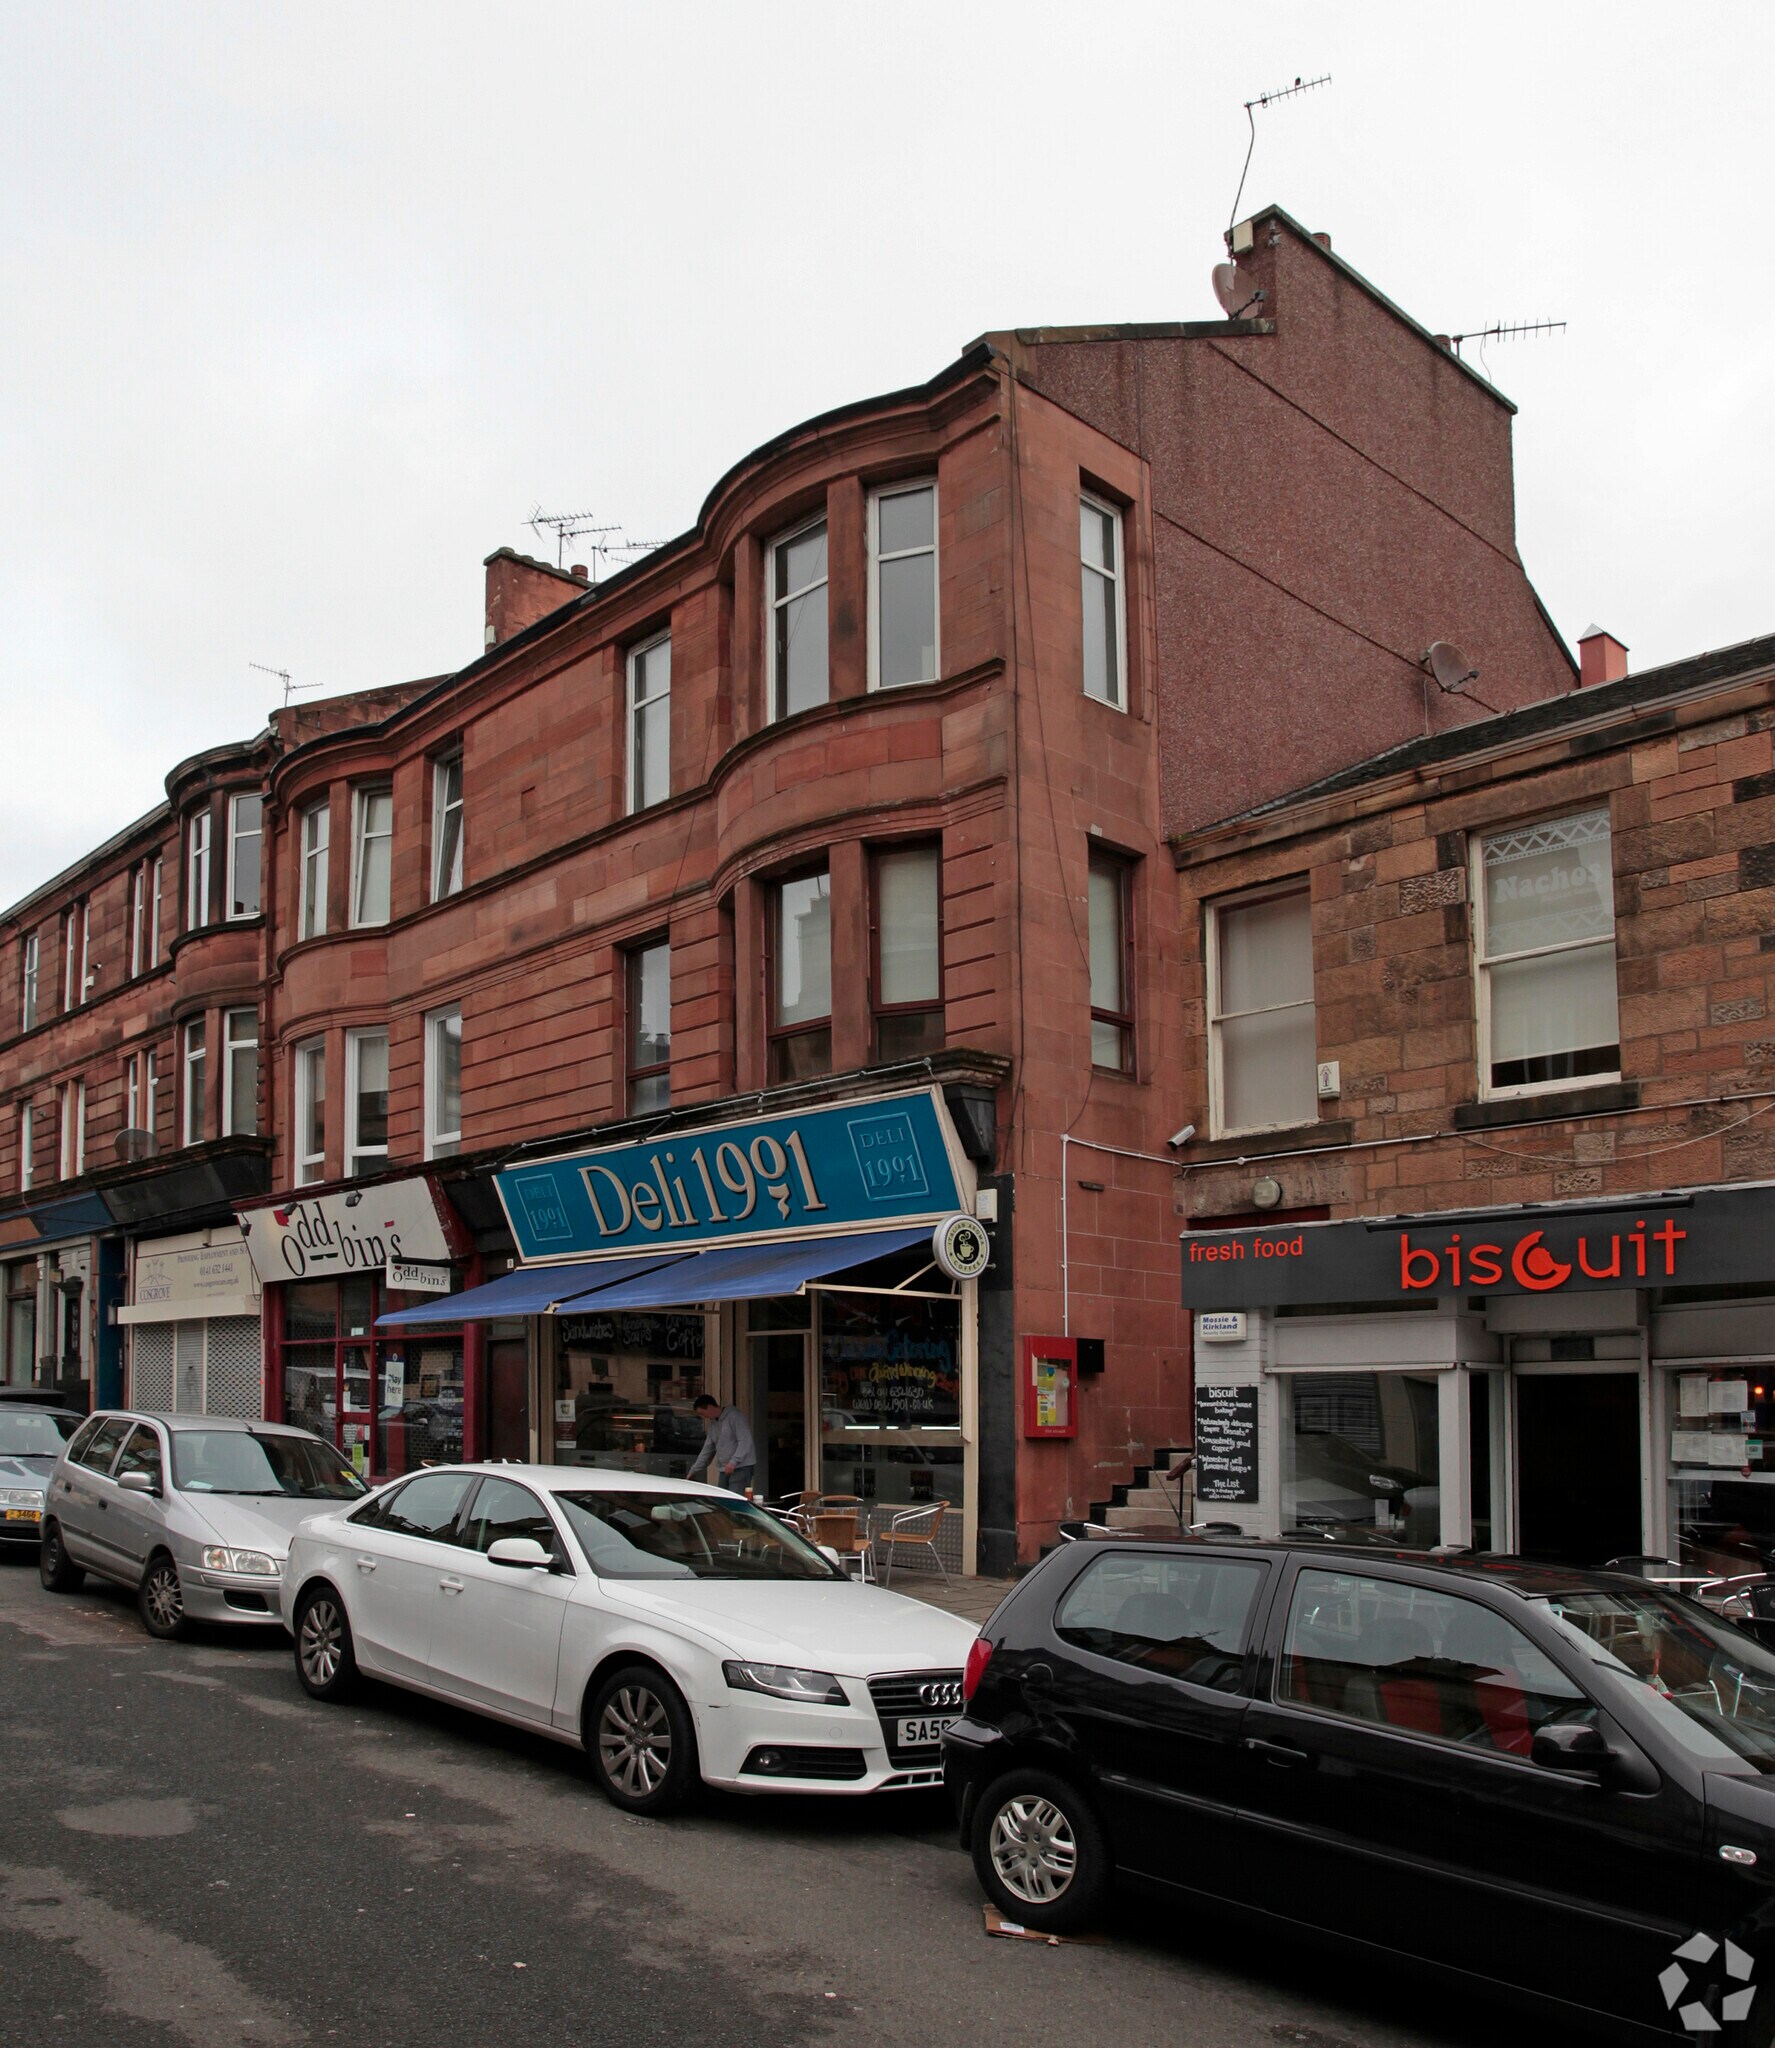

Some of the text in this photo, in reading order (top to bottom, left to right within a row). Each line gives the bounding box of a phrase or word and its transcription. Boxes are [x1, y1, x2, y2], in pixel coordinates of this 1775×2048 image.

[1494, 863, 1602, 904] Nachos
[860, 1128, 907, 1148] DELI
[524, 1184, 557, 1201] DELI
[948, 1223, 966, 1245] ITALIAN
[1190, 1235, 1304, 1263] fresh food
[1401, 1219, 1687, 1291] biscuit
[953, 1260, 981, 1272] COFFEE
[140, 1286, 171, 1302] COSGROVE
[1202, 1316, 1229, 1324] Mossie
[388, 1373, 402, 1385] Play
[386, 1384, 402, 1395] here
[1208, 1387, 1239, 1398] biscuit
